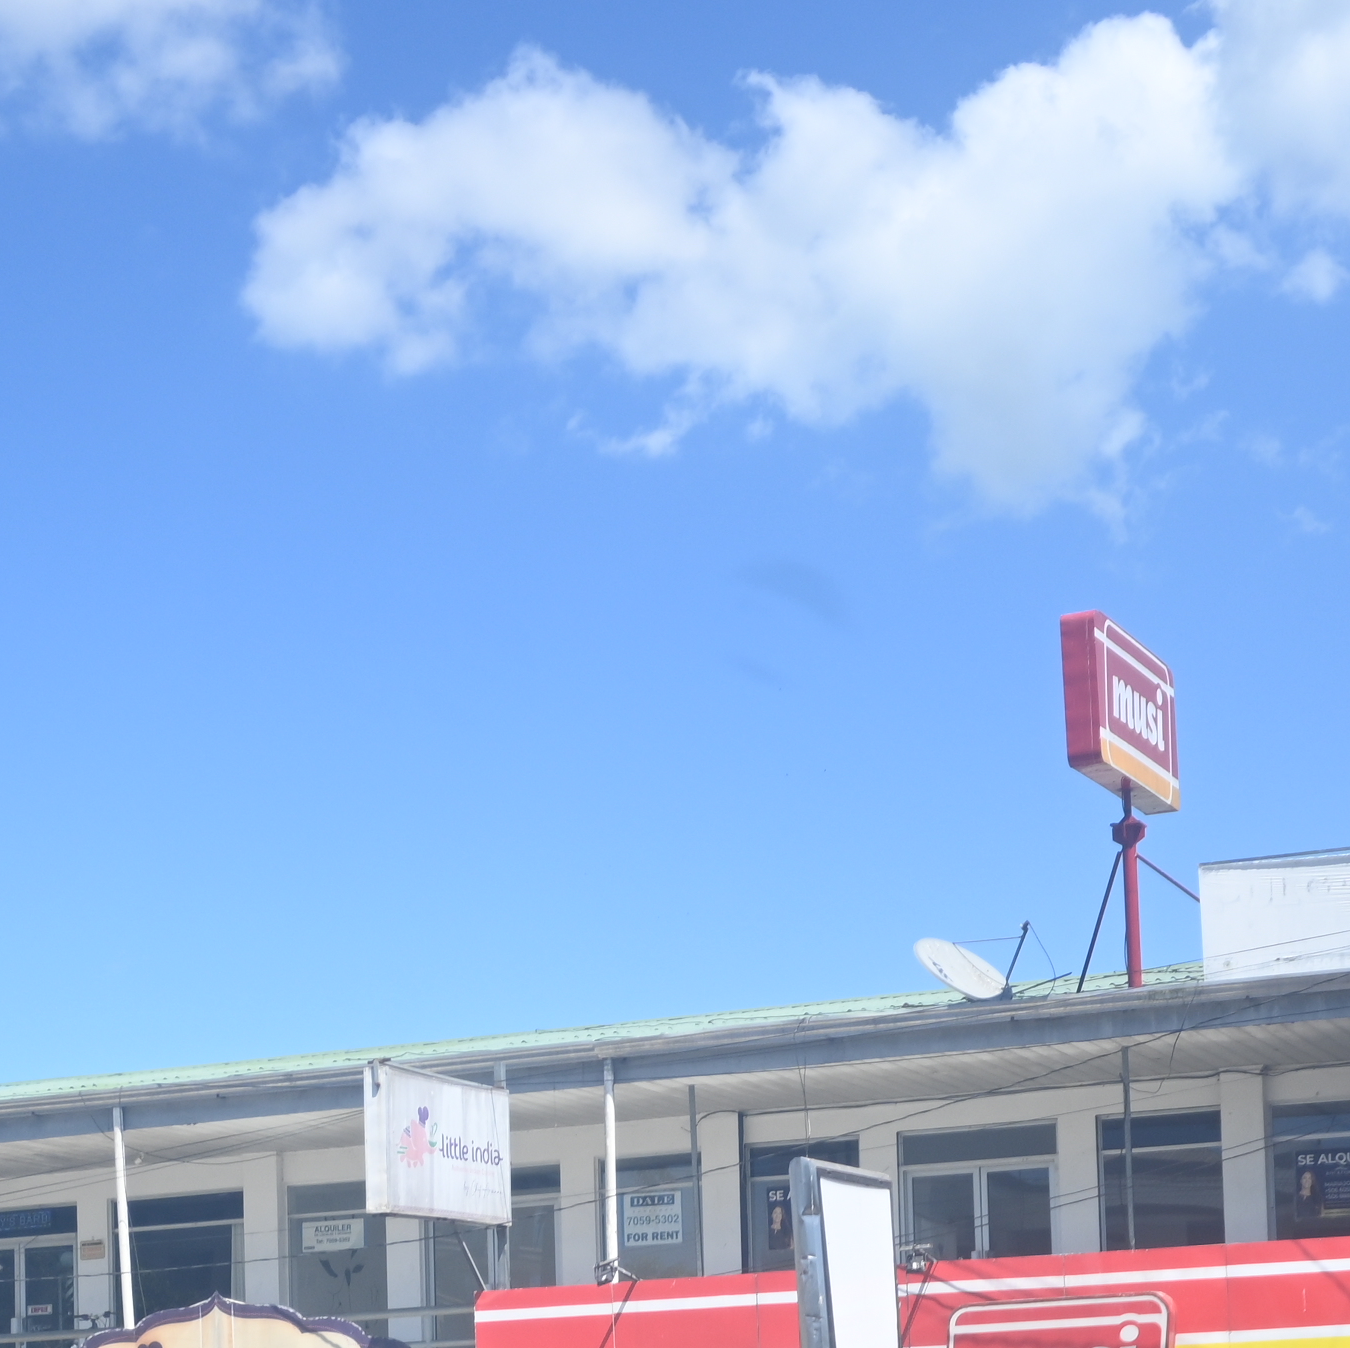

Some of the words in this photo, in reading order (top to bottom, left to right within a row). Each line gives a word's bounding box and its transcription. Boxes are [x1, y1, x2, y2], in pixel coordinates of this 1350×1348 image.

[1112, 673, 1165, 752] musi
[439, 1133, 469, 1162] little
[471, 1140, 504, 1166] india
[1297, 1153, 1315, 1166] SE
[632, 1195, 674, 1207] DALE
[768, 1189, 785, 1202] SE
[626, 1213, 680, 1226] 7059-5302
[314, 1223, 352, 1234] ALQUILER
[626, 1232, 649, 1243] FOR
[651, 1230, 680, 1242] RENT
